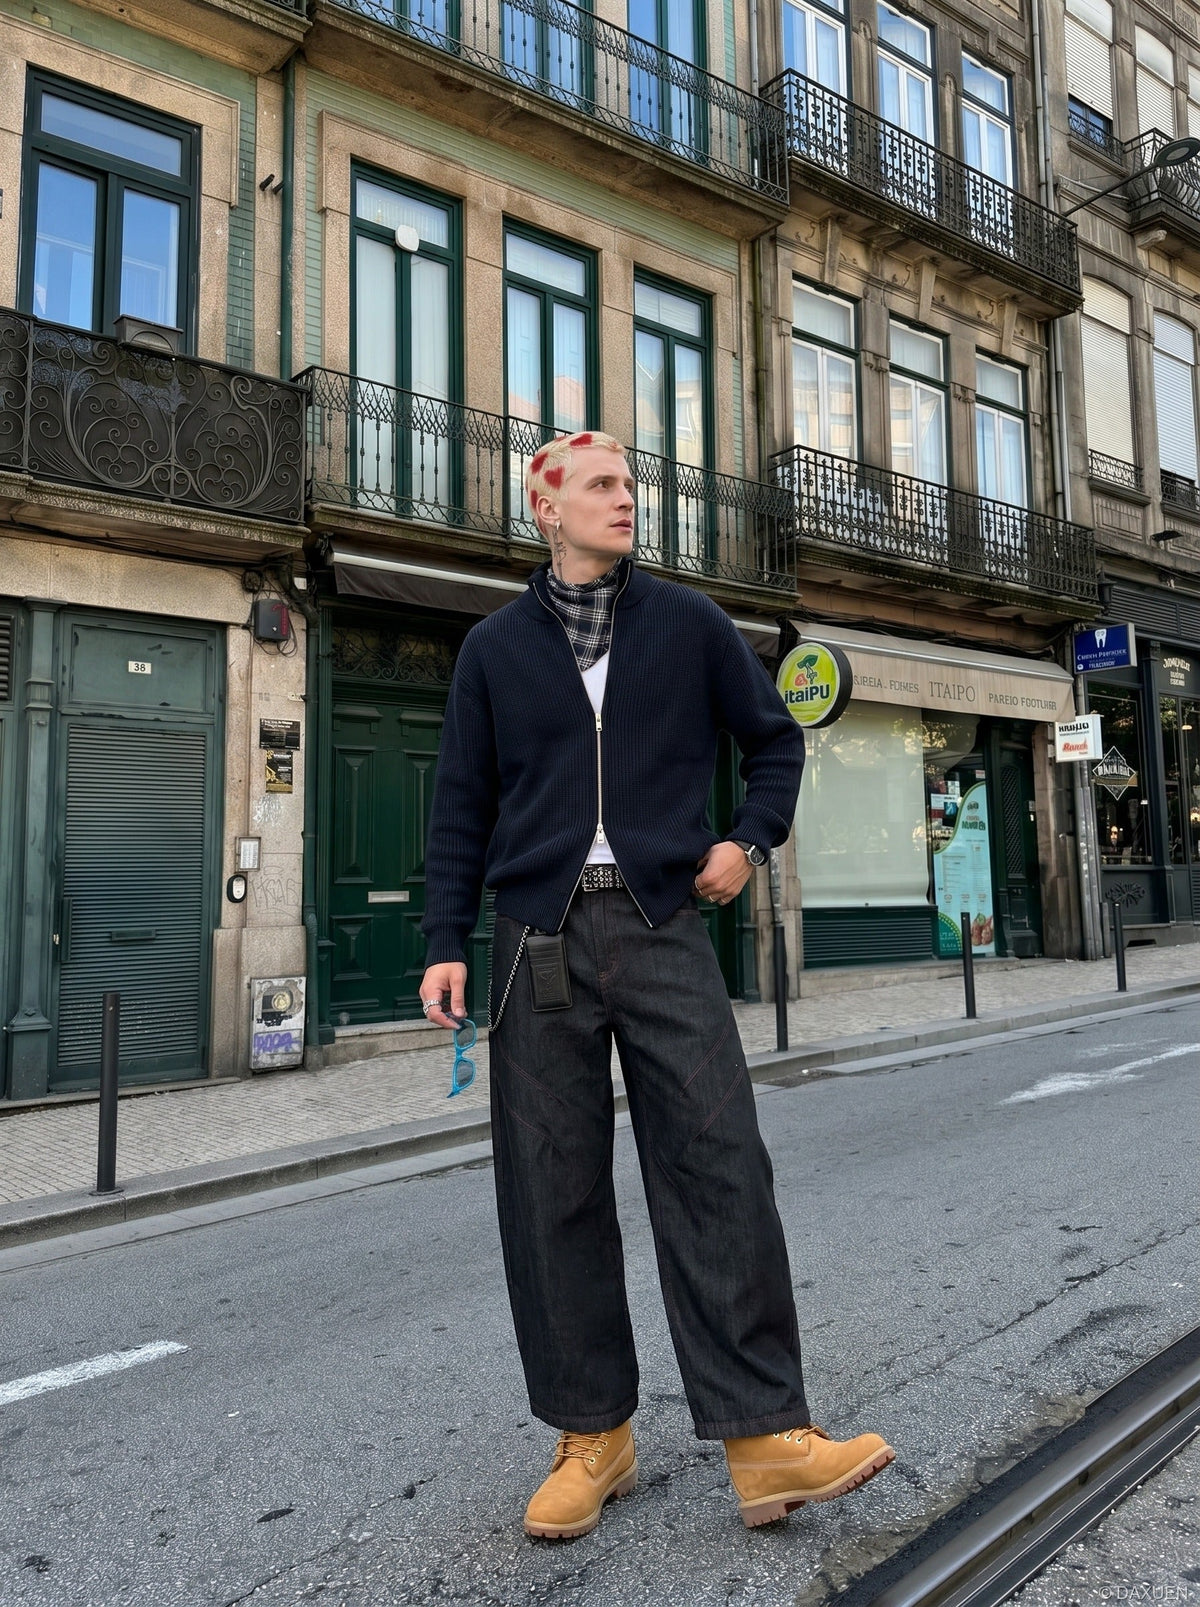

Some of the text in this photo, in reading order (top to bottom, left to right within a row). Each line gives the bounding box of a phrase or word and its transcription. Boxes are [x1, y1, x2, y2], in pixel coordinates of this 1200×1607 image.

[134, 663, 146, 672] 38
[784, 684, 830, 704] itaiPU
[929, 681, 976, 702] ITAIPO
